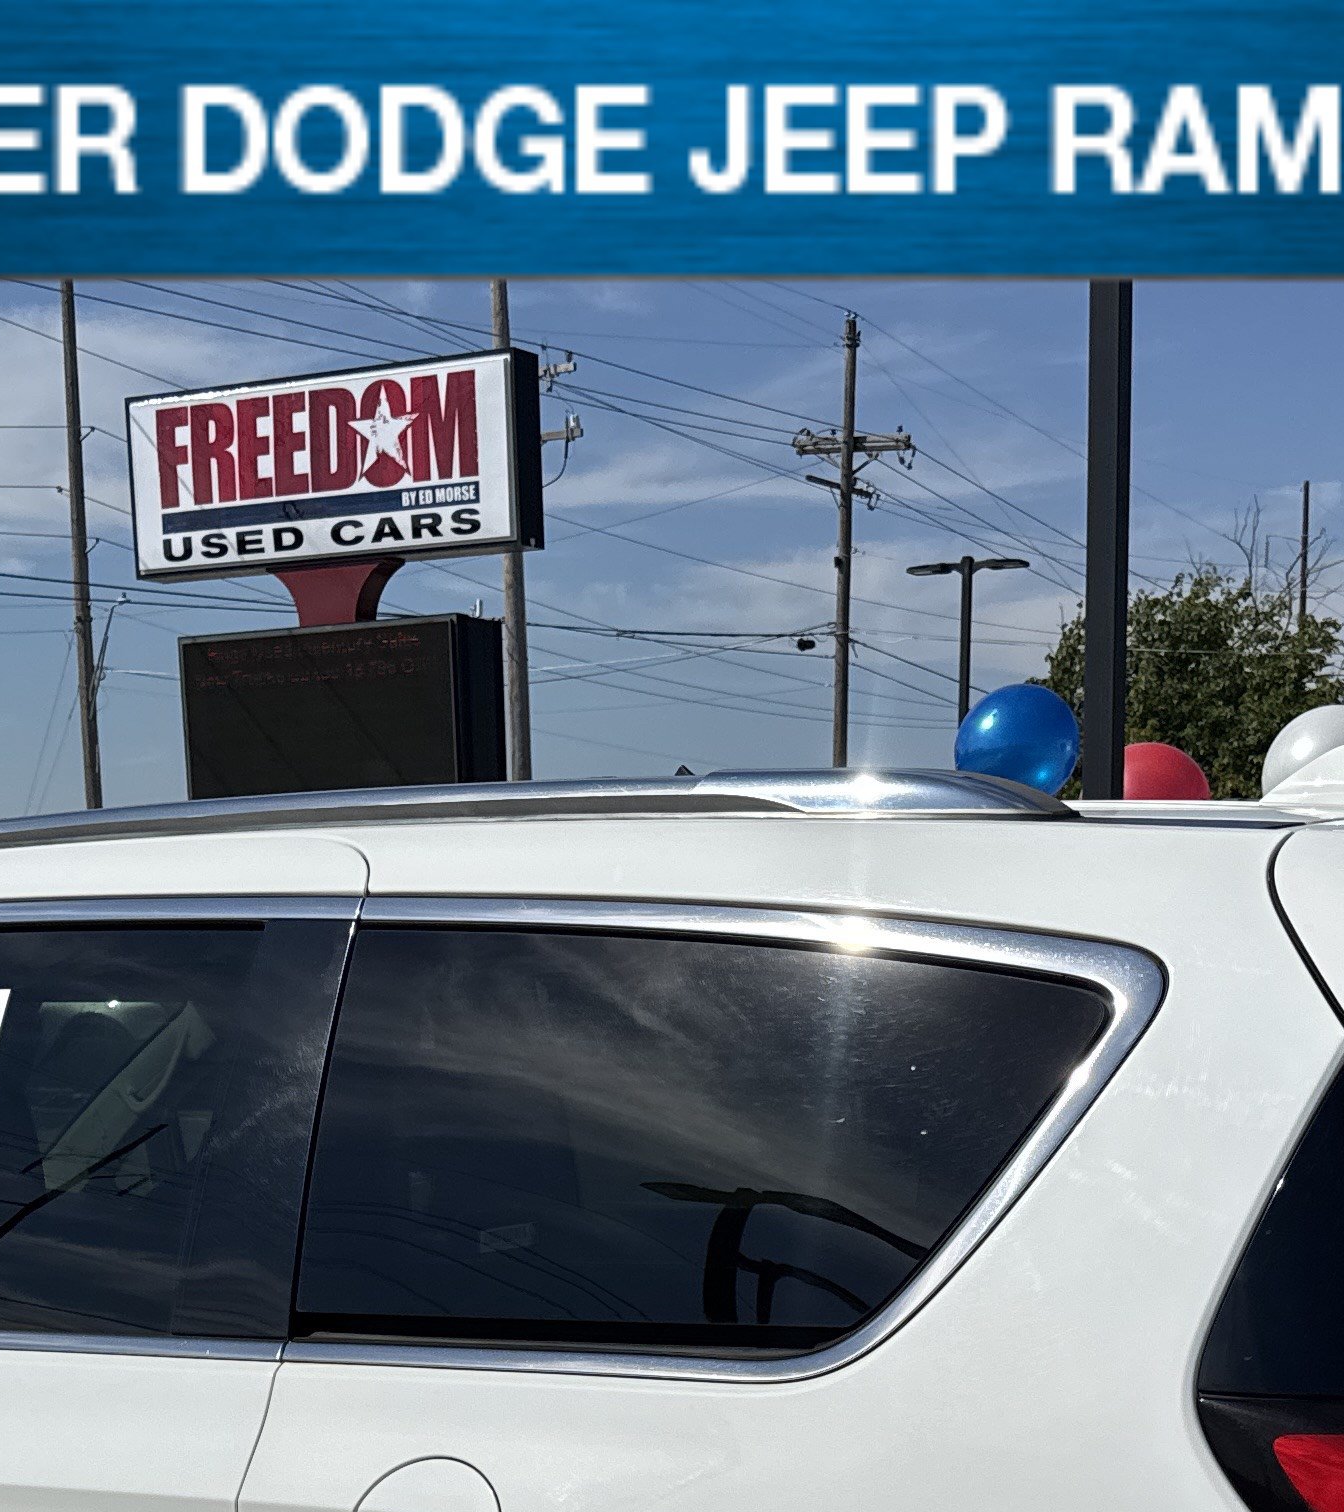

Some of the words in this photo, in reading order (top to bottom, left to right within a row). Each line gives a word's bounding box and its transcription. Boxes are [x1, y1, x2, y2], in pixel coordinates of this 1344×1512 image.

[155, 369, 479, 510] FREEDOM
[401, 490, 417, 507] BY
[419, 487, 433, 505] ED
[435, 484, 476, 503] MORSE
[162, 526, 305, 563] USED
[330, 507, 481, 546] CARS
